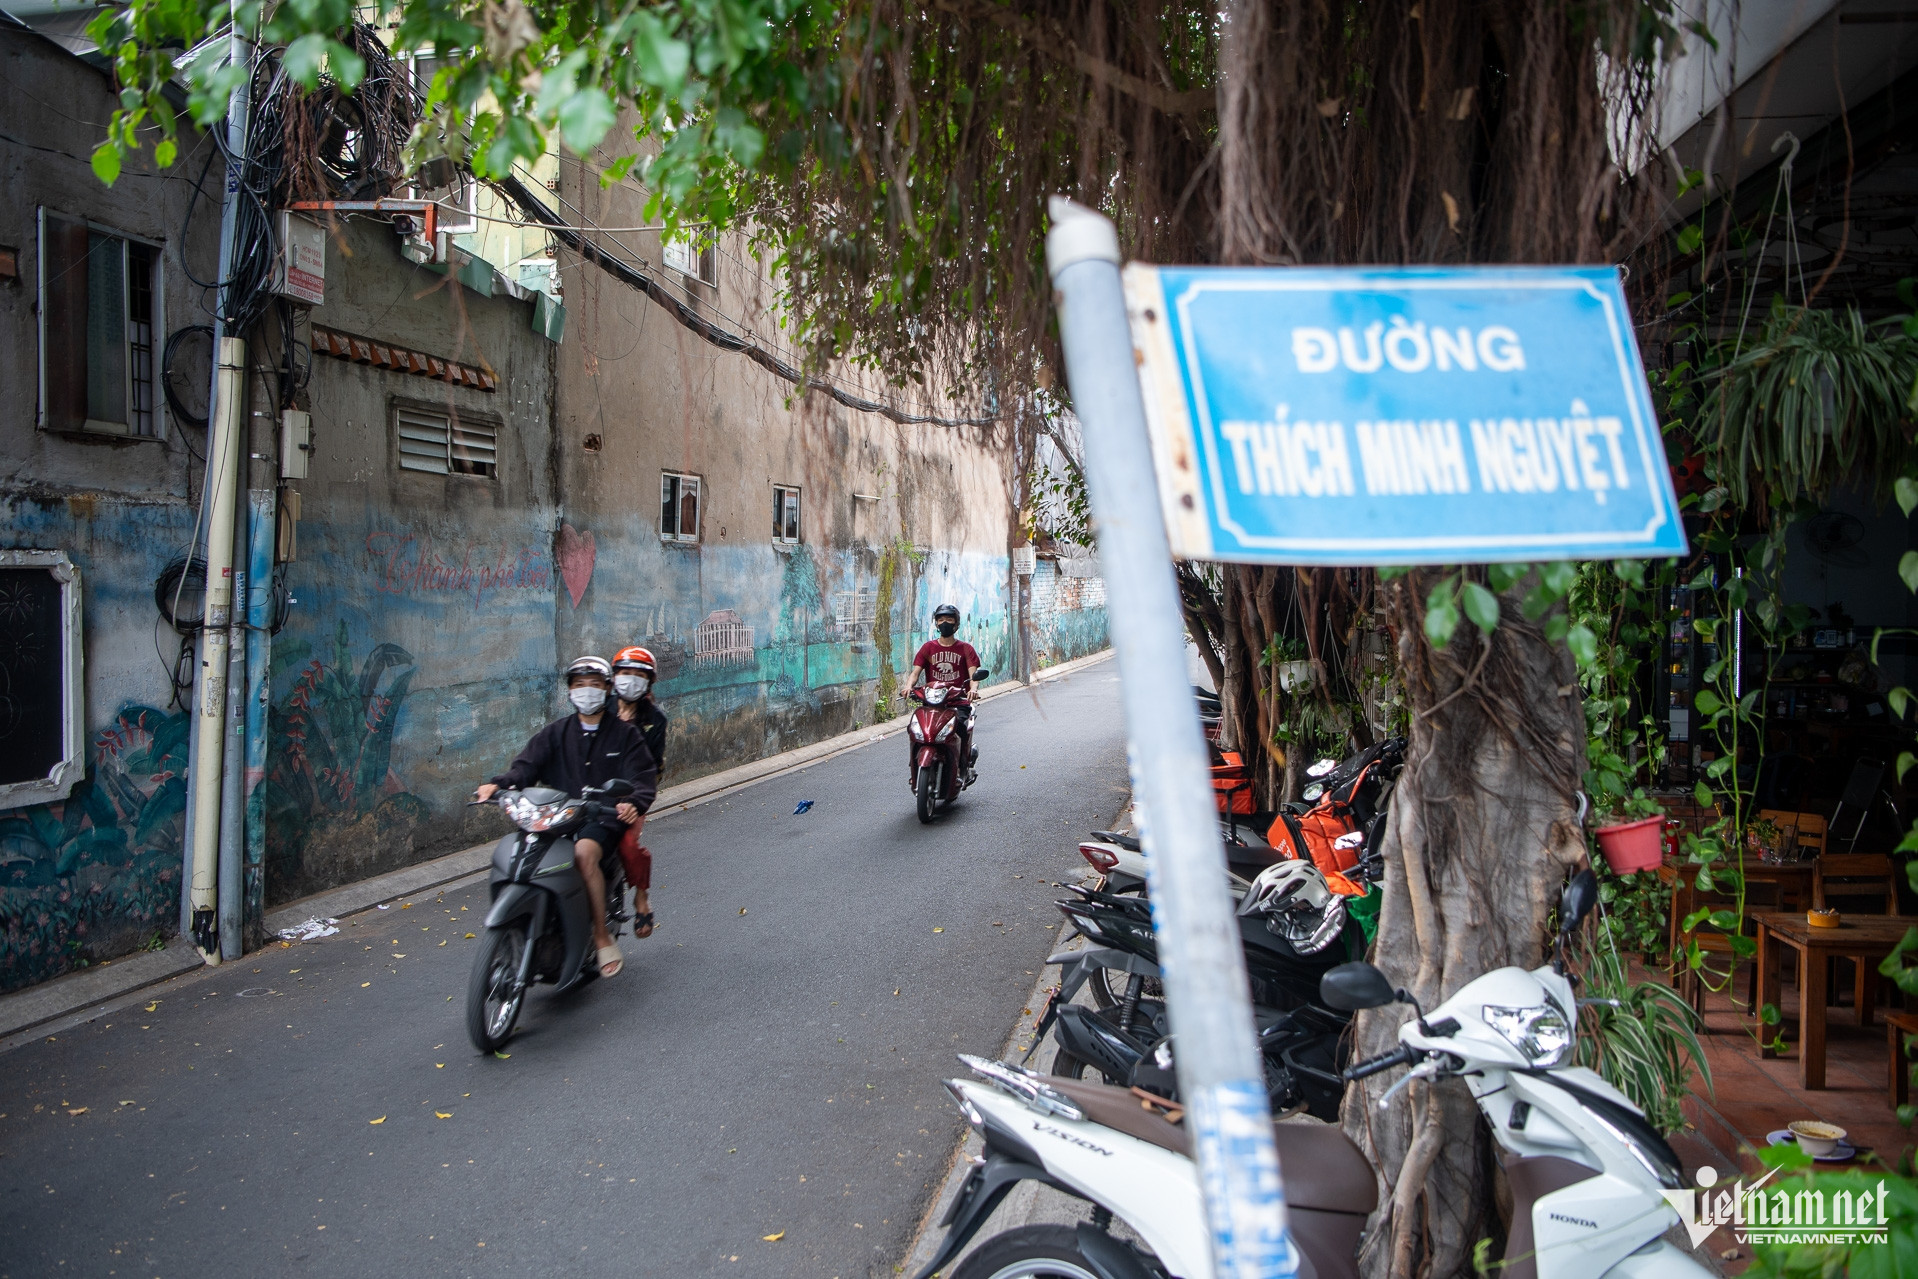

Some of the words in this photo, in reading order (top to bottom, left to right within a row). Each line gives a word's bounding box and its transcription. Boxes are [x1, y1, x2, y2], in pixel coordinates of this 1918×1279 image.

[301, 273, 324, 287] INTERNET
[1291, 315, 1527, 374] ĐƯỜNG
[1220, 402, 1355, 498] THÍCH
[1355, 419, 1471, 496] MINH
[1469, 398, 1630, 506] NGUYỆT
[366, 531, 473, 594] Thành
[475, 540, 517, 611] phố
[931, 651, 944, 665] OLD
[944, 651, 962, 666] NAVY
[932, 669, 960, 681] CALIFORNIA
[1032, 1119, 1114, 1156] VISION
[1550, 1212, 1598, 1229] HONDA
